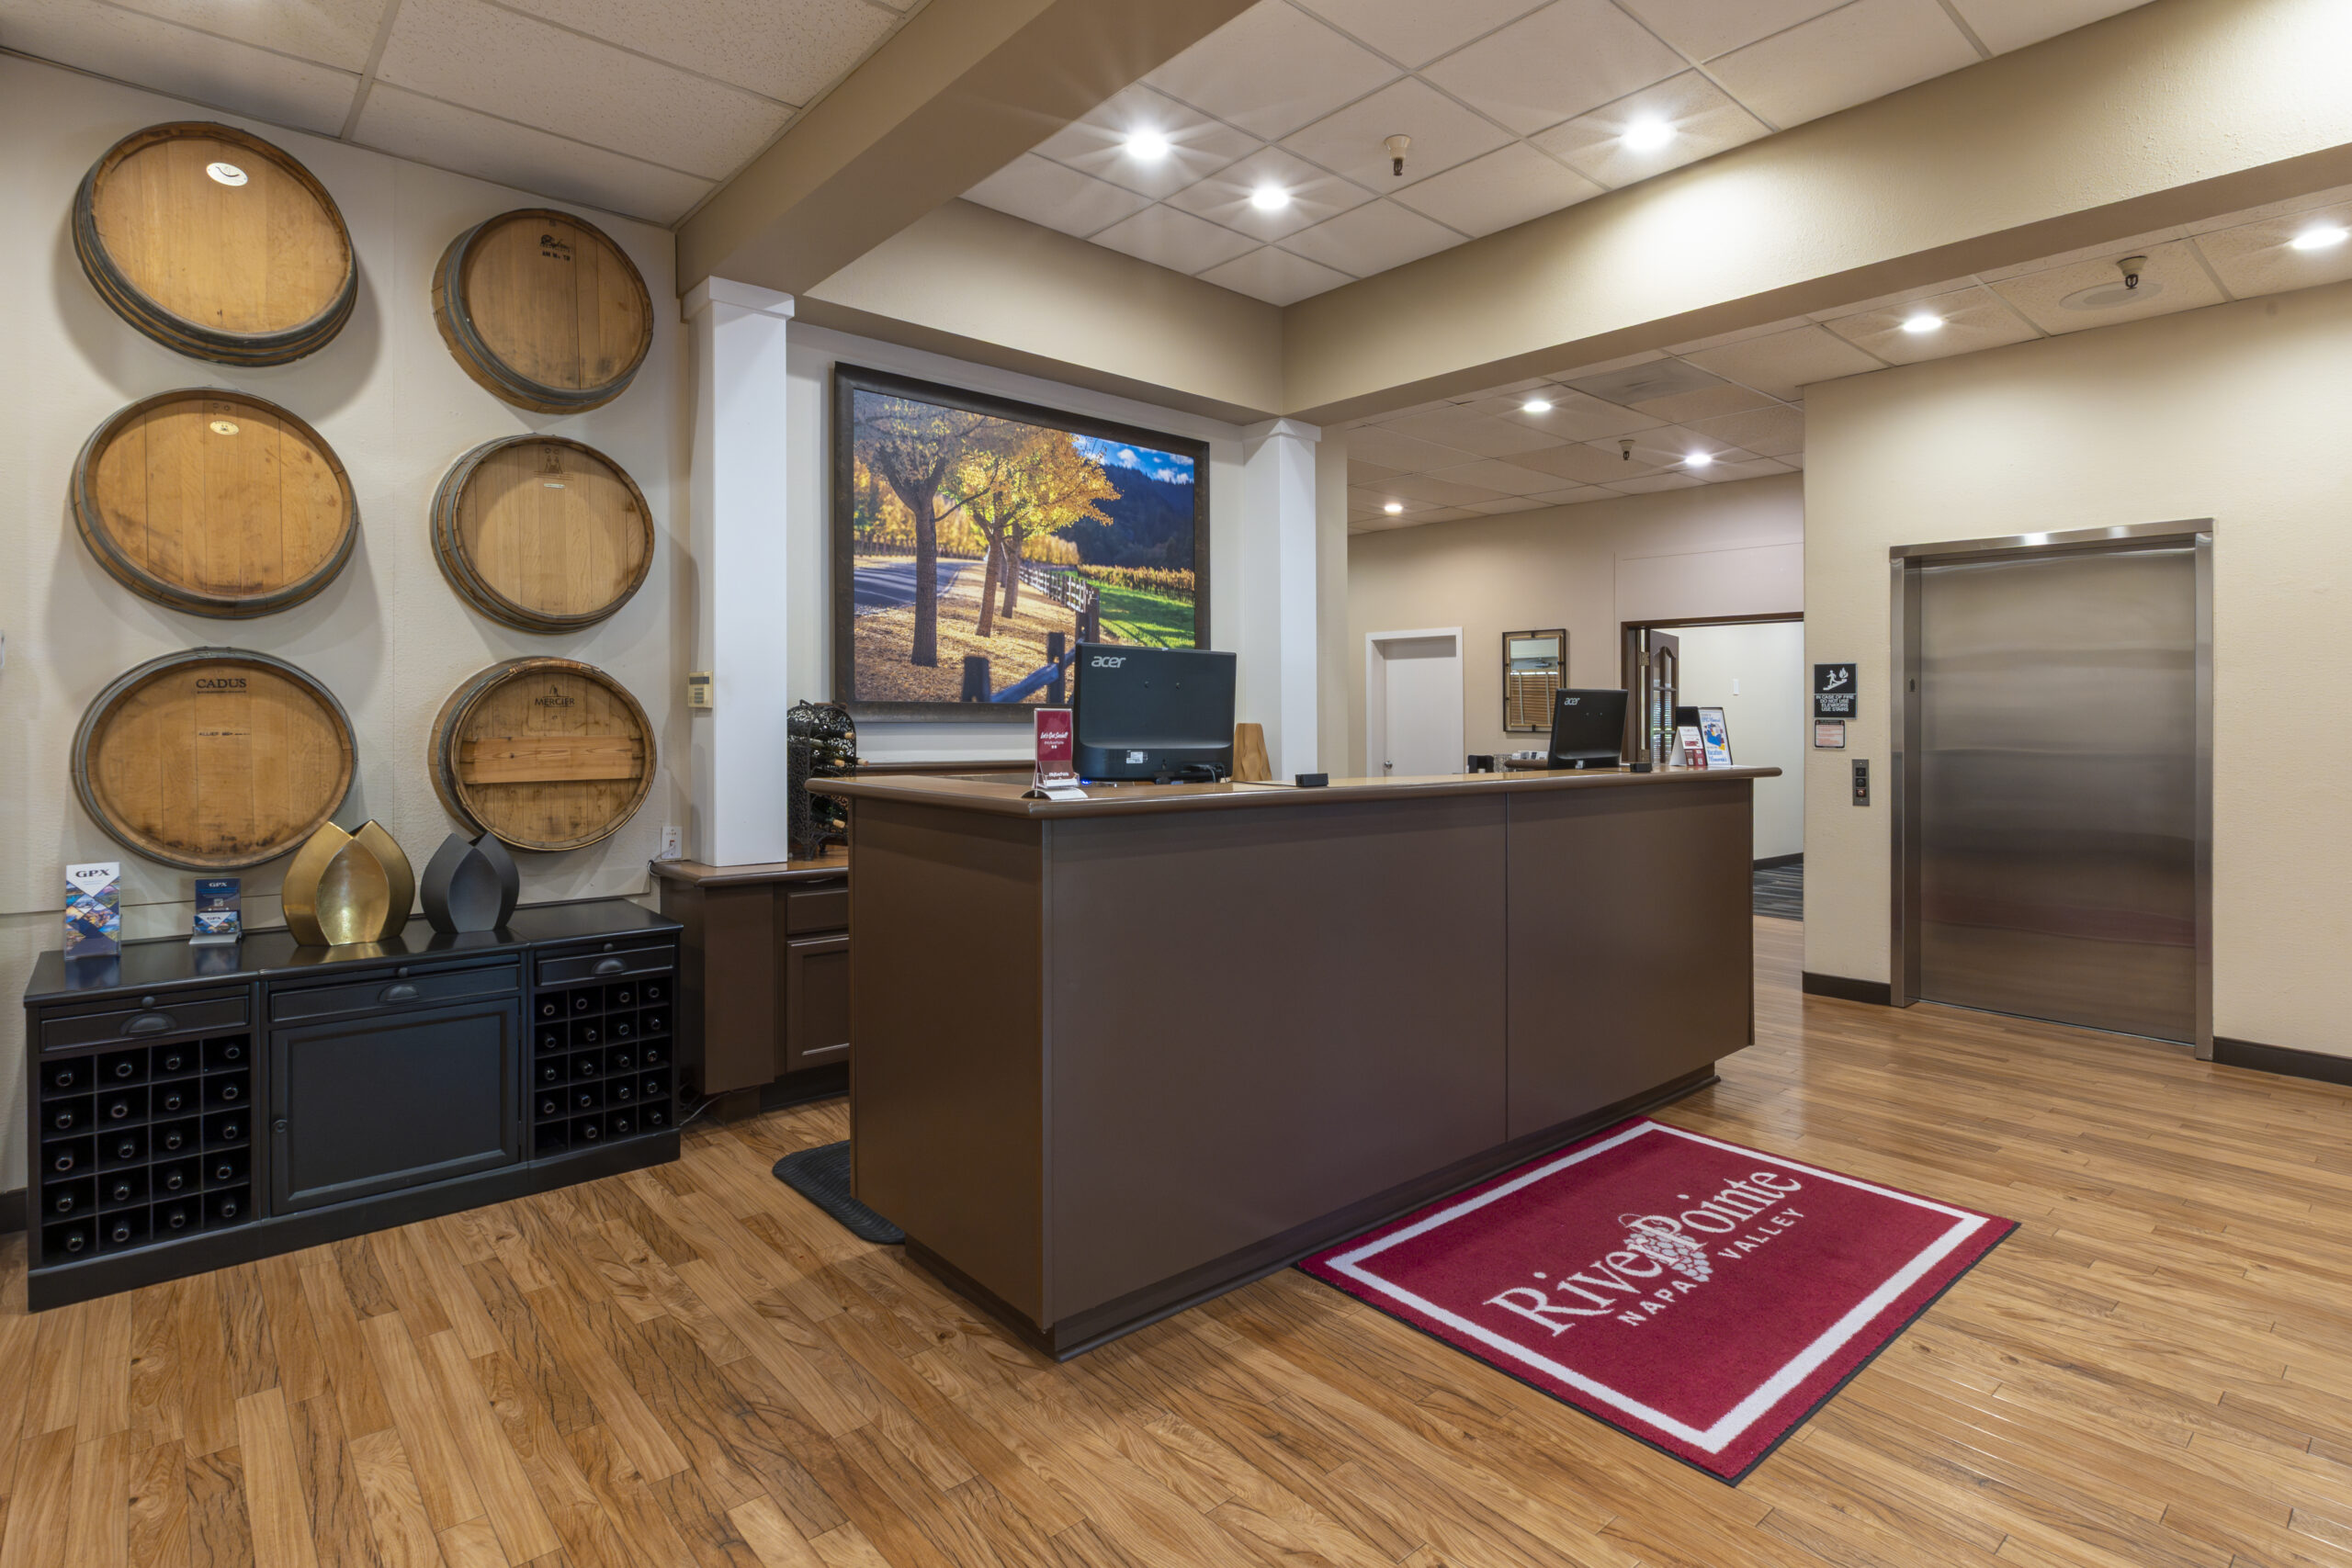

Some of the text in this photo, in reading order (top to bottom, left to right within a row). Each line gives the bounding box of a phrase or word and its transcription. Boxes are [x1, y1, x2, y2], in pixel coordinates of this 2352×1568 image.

[1091, 656, 1126, 669] acer
[196, 678, 247, 689] CADUS
[535, 697, 575, 705] MERCIER
[75, 869, 110, 877] GPX
[1617, 1208, 1805, 1326] NAPA VALLEY
